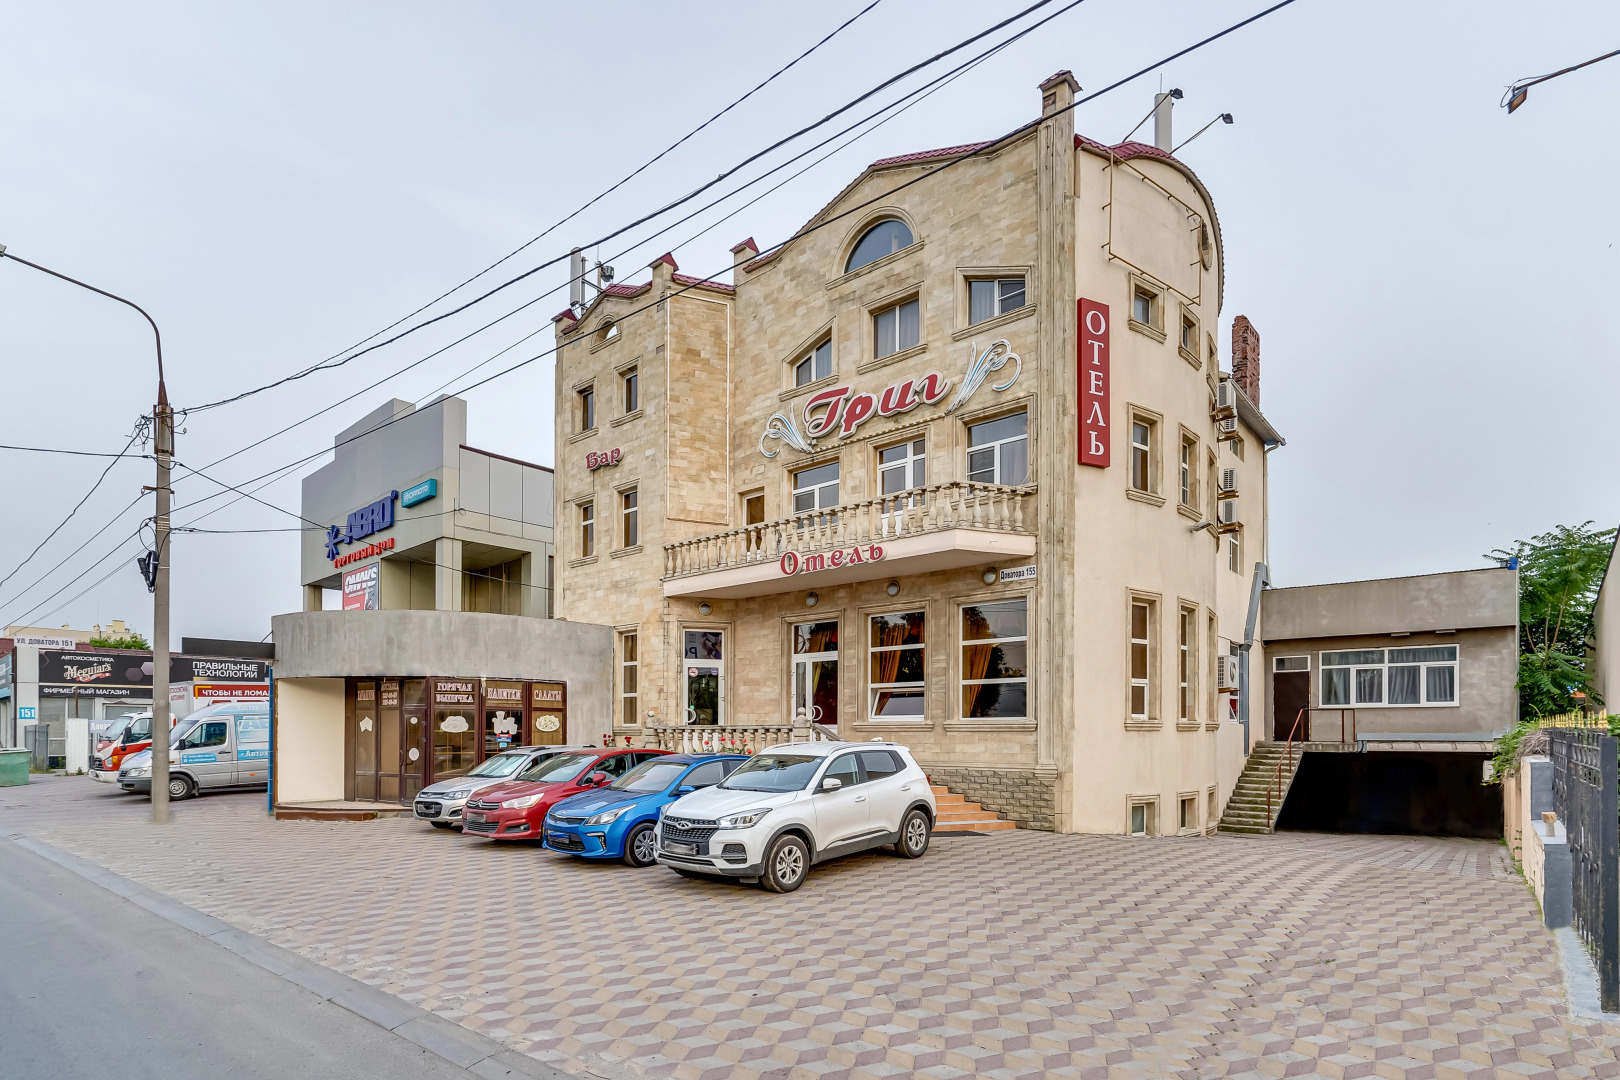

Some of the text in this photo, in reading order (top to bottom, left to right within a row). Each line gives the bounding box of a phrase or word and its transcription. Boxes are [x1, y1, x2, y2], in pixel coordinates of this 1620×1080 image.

[1085, 310, 1106, 456] ОТЕЛЬ
[803, 371, 945, 438] Григ
[586, 447, 622, 470] Бар
[780, 544, 885, 576] Отель
[1000, 566, 1036, 581] Доватора 155
[28, 638, 60, 647] ДОВАТОРА
[61, 655, 114, 663] АВТОКОСМЕТИКА
[192, 661, 258, 672] ПРАВИЛЬНЫЕ
[192, 668, 258, 679] ТЕХНОЛОГИИ
[202, 689, 231, 697] ЧТОБЫ
[232, 689, 242, 697] НЕ
[20, 708, 35, 718] 151
